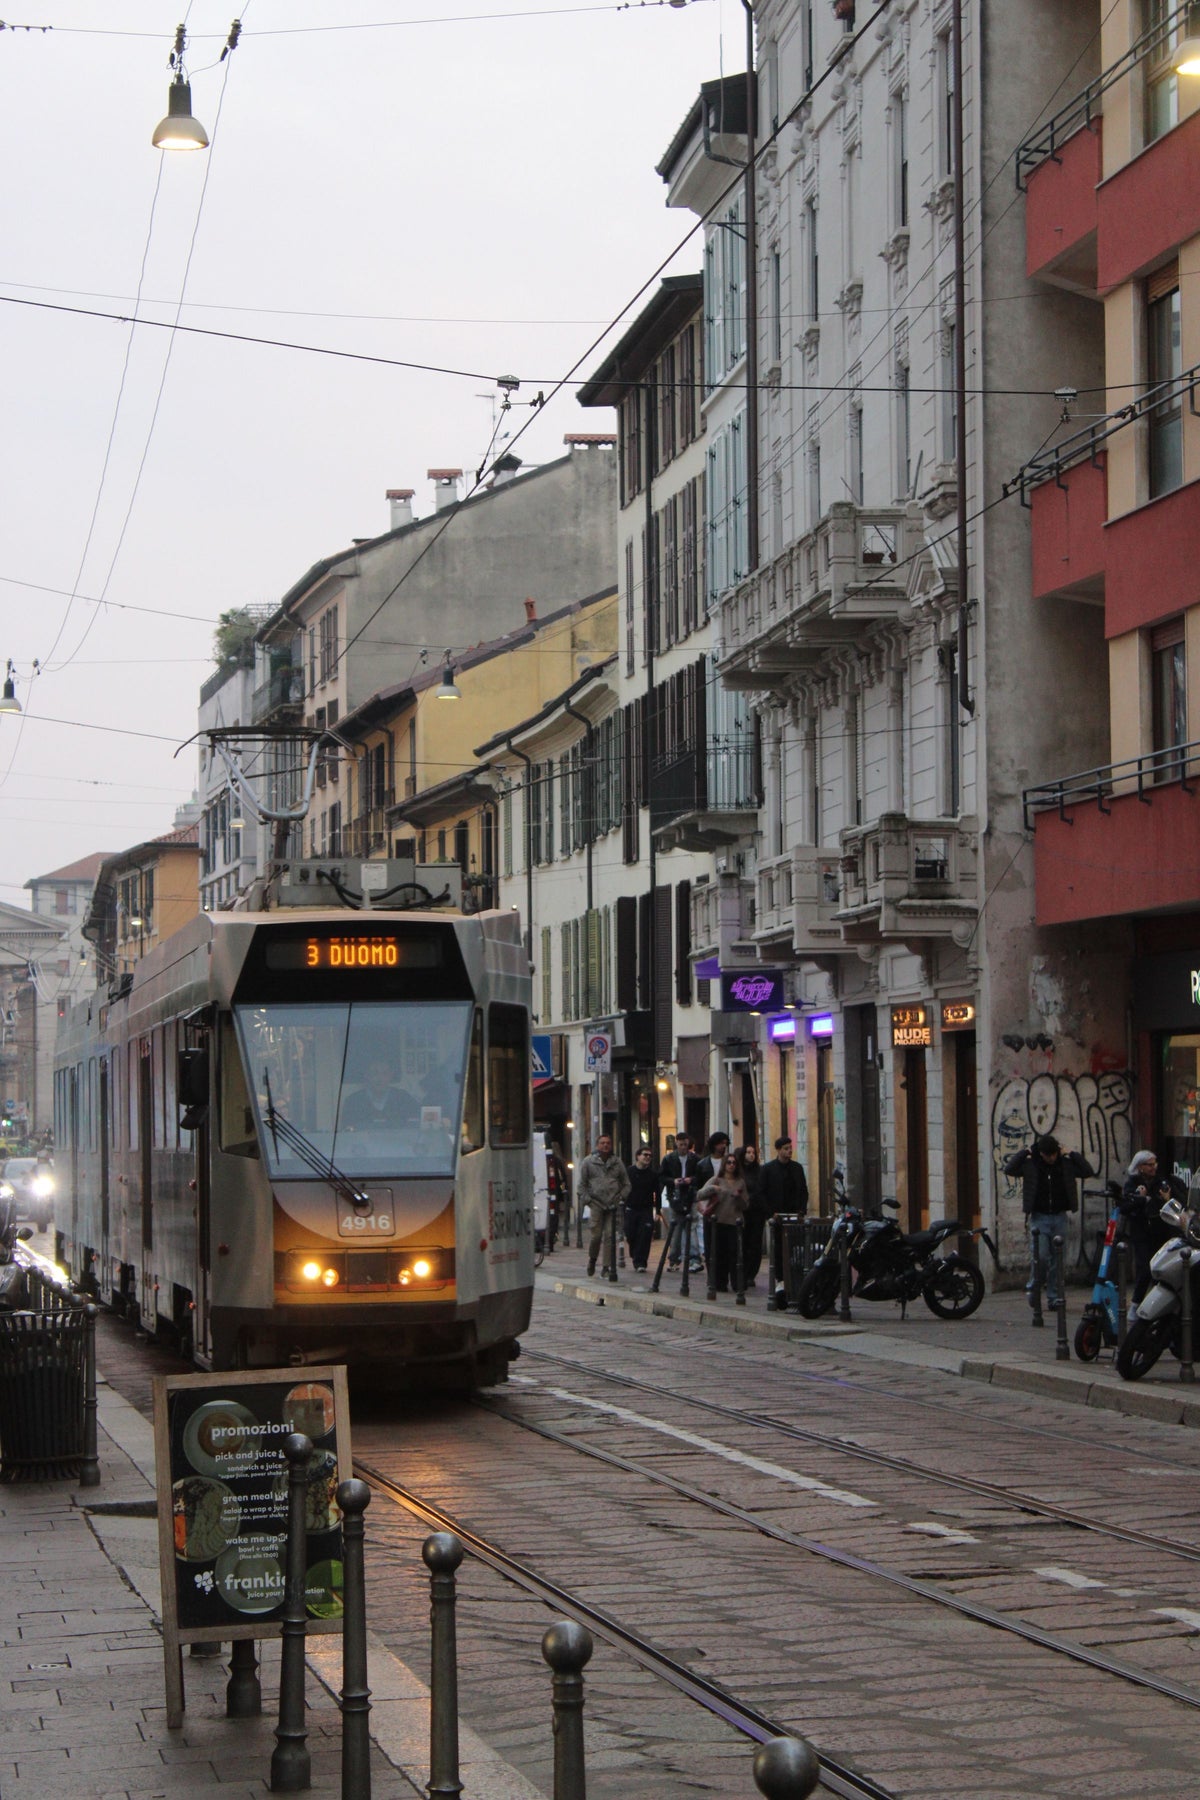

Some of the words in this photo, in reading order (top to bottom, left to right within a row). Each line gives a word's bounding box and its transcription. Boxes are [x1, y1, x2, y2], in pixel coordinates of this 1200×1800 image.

[307, 944, 319, 966] 3
[330, 944, 397, 966] DUOMO
[893, 1027, 931, 1039] NUDE
[341, 1214, 391, 1231] 4916
[211, 1419, 295, 1441] promozioni
[215, 1451, 234, 1463] pick
[235, 1450, 253, 1459] and
[254, 1449, 277, 1460] juice
[227, 1464, 259, 1472] sandwich
[265, 1462, 283, 1471] juice
[222, 1495, 249, 1505] green
[250, 1491, 273, 1501] meal
[223, 1506, 242, 1515] salad
[272, 1504, 289, 1513] juice
[225, 1535, 249, 1544] wake
[266, 1535, 278, 1544] up
[247, 1591, 264, 1600] juice
[265, 1590, 281, 1598] your
